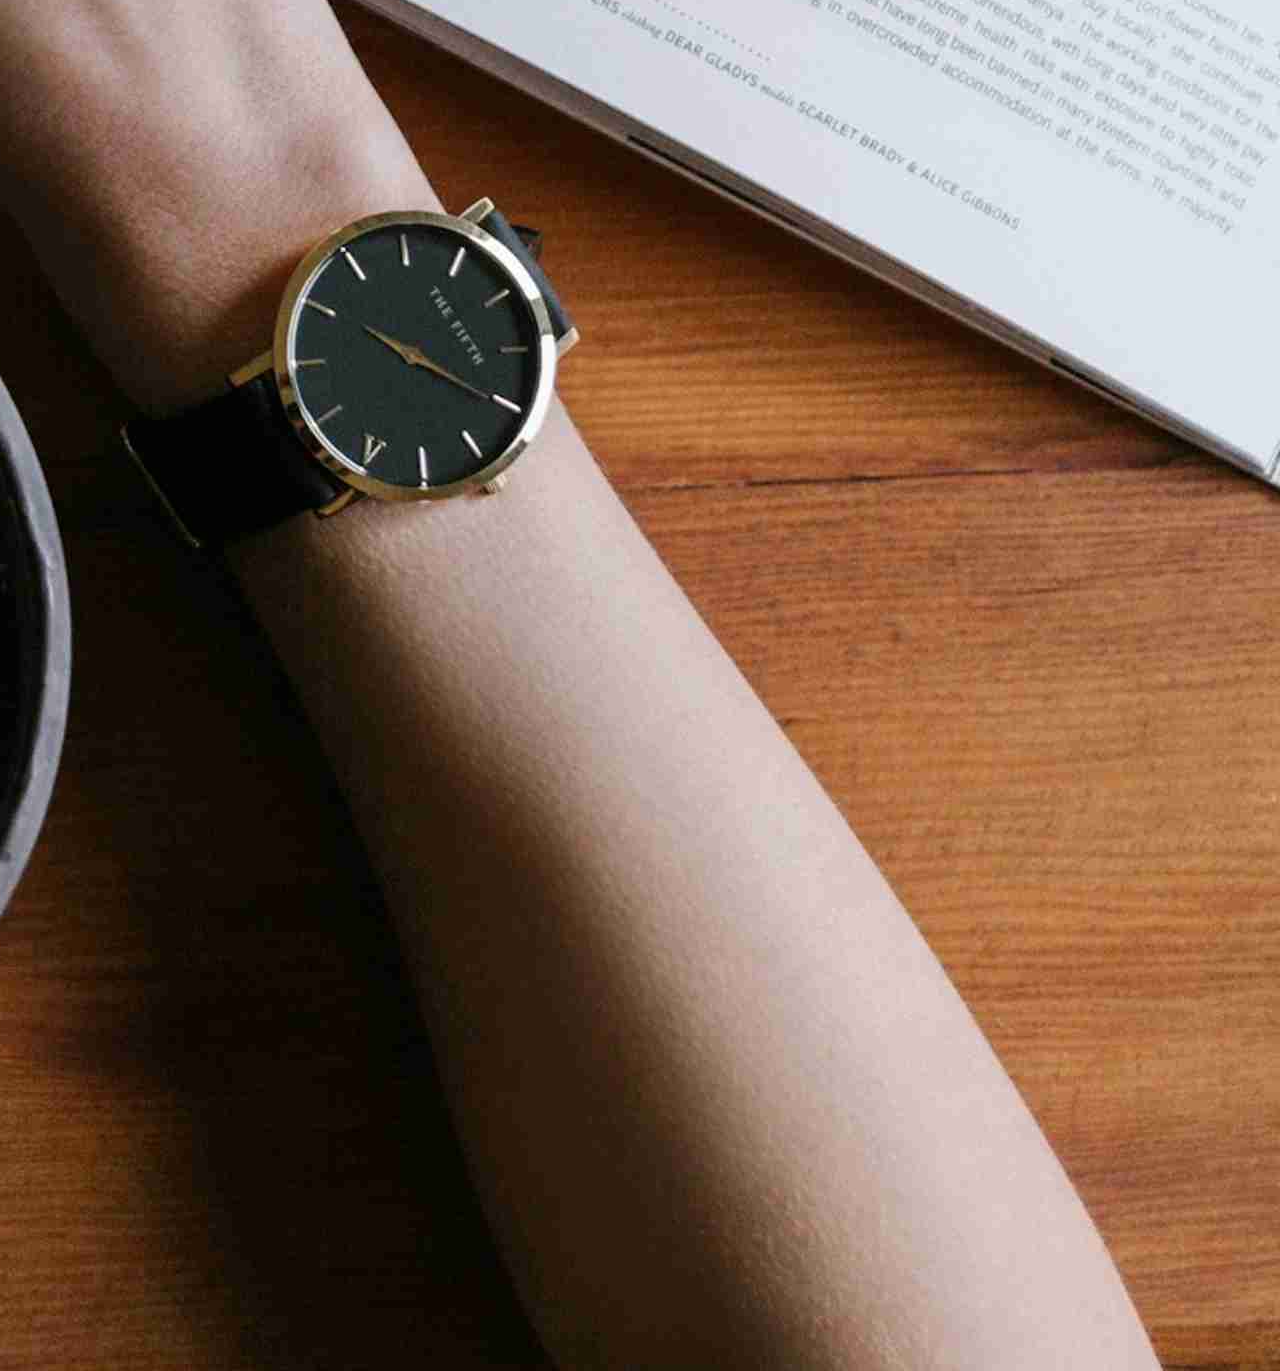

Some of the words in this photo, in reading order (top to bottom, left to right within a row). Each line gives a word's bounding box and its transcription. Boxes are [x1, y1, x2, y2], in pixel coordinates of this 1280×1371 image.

[663, 30, 702, 58] DEAR
[704, 51, 758, 87] GLADYS
[796, 101, 858, 141] SCARLET
[858, 134, 904, 166] BRADY
[919, 167, 958, 195] ALICE
[960, 189, 1020, 230] GIBBONS
[846, 11, 938, 66] overcrowded
[940, 62, 1051, 130] accommodation
[1055, 126, 1073, 141] at
[1074, 134, 1097, 156] the
[1148, 174, 1174, 199] The
[430, 285, 453, 318] THE
[450, 320, 484, 365] FIFTH
